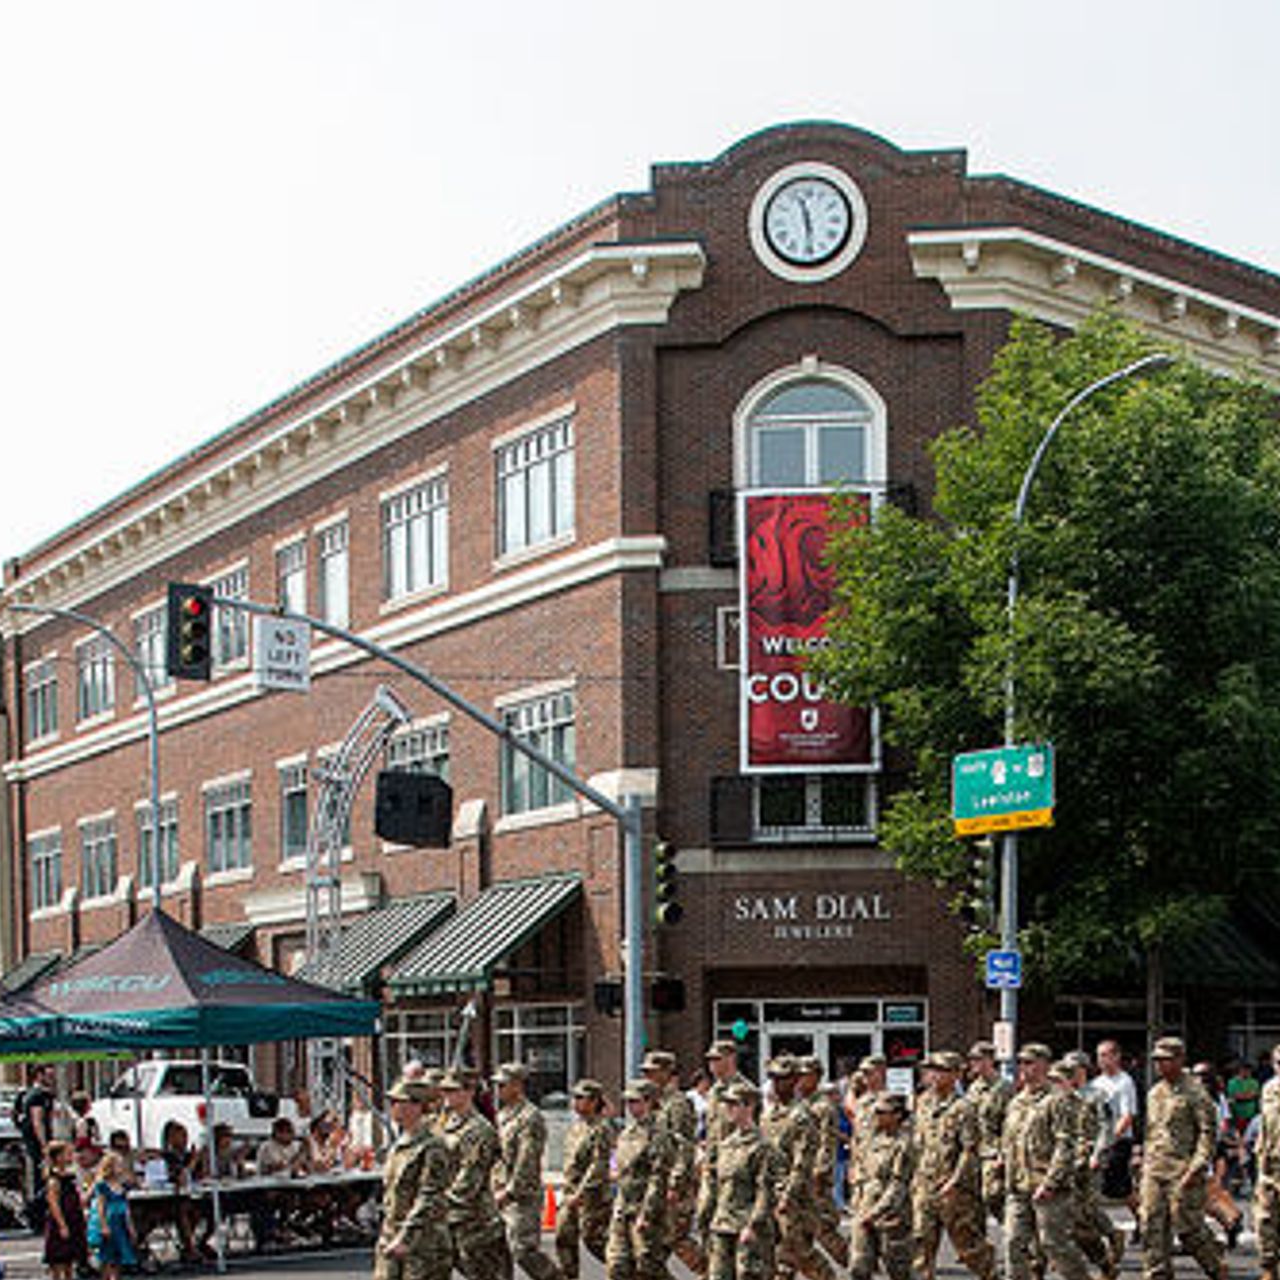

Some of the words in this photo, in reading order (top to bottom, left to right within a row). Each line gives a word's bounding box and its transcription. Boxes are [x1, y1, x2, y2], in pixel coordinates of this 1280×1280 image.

[275, 629, 296, 646] NO
[267, 648, 300, 666] LEFT
[734, 896, 798, 921] SAM
[815, 894, 892, 920] DIAL
